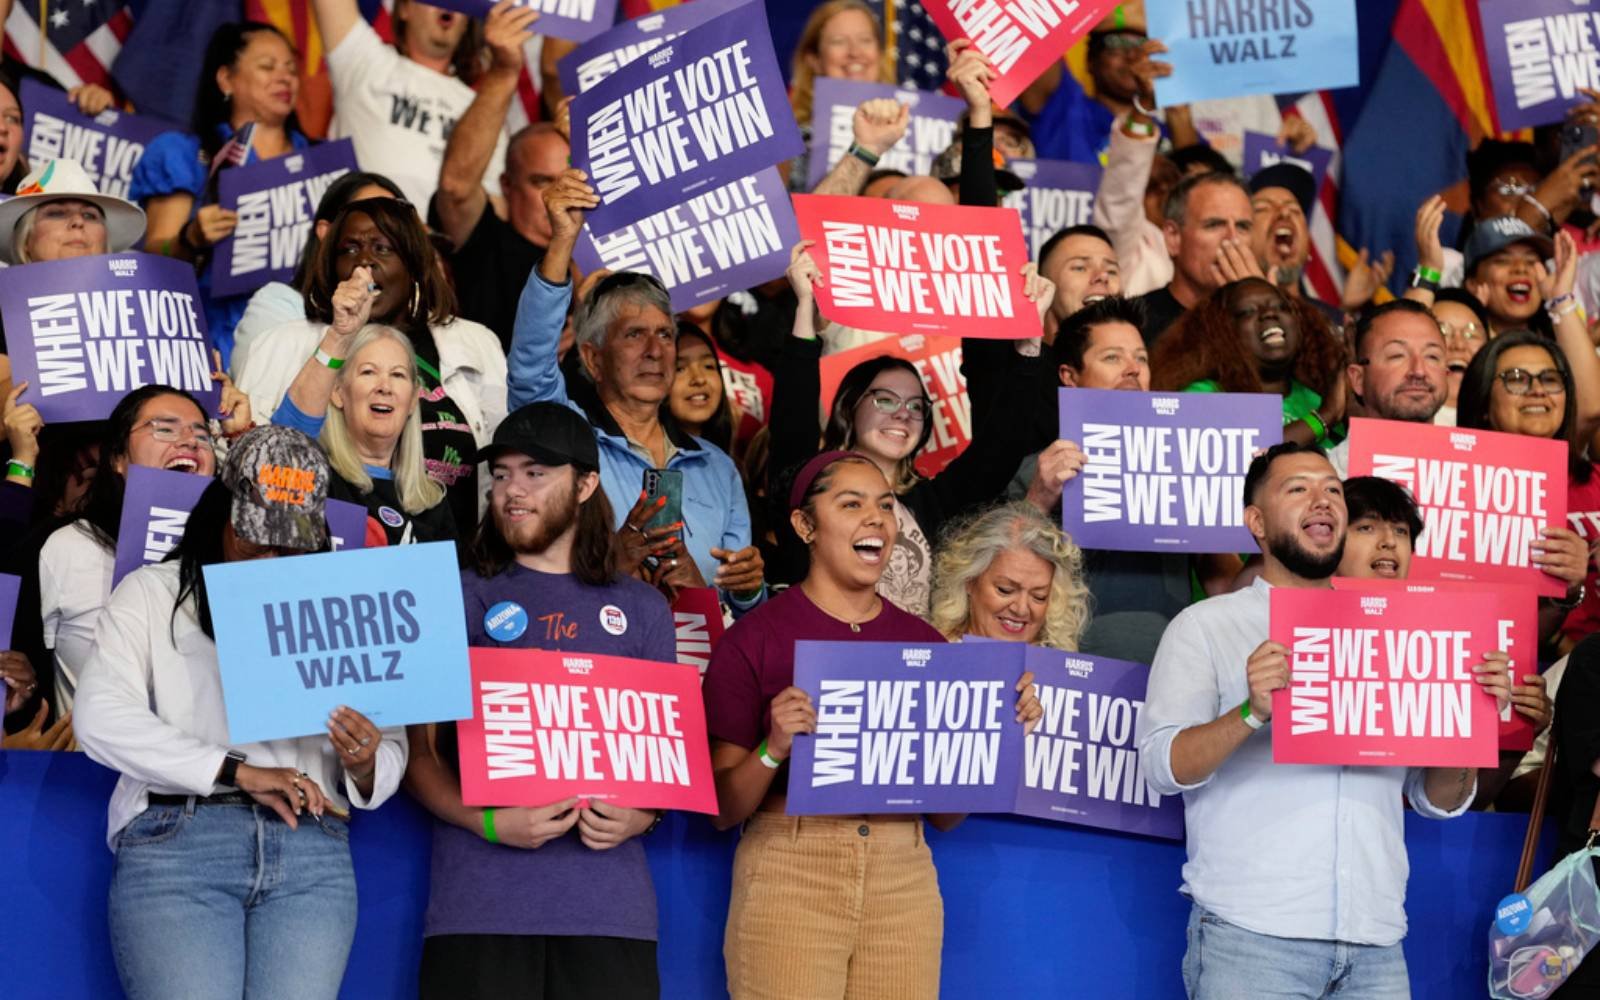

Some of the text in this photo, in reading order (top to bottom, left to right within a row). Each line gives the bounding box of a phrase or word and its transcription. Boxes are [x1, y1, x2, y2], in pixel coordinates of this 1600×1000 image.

[947, 0, 1032, 75] WHE
[1187, 0, 1313, 39] HARRIS
[1544, 11, 1596, 56] WE
[1209, 34, 1298, 65] WALZ
[1504, 17, 1556, 110] WHEN
[624, 75, 677, 134] WE
[674, 39, 757, 112] VOTE
[63, 122, 145, 182] WE VO
[587, 99, 641, 205] WHEN
[630, 118, 698, 186] WE
[687, 85, 774, 162] WIN
[270, 180, 310, 228] WE
[637, 204, 689, 241] WE
[230, 190, 270, 277] WHEN
[645, 202, 783, 290] WE WIN
[866, 225, 920, 271] WE
[920, 232, 1006, 273] VOTE
[822, 221, 874, 307] WHEN
[872, 267, 1015, 318] WE WIN
[78, 289, 203, 339] WE VOTE
[27, 293, 88, 396] WHEN
[85, 338, 213, 392] WE WIN
[1082, 423, 1122, 523] WHEN
[1123, 425, 1260, 474] WE VOTE
[1123, 473, 1178, 526] WE
[1418, 458, 1467, 508] WE
[1473, 464, 1547, 517] VOTE
[1415, 507, 1467, 561] WE
[263, 589, 420, 657] HARRIS
[538, 612, 579, 641] The
[296, 650, 404, 690] WALZ
[1291, 627, 1330, 735] WHEN
[1332, 628, 1379, 679] WE
[1384, 630, 1472, 680] VOTE
[480, 681, 536, 780] WHEN
[531, 683, 683, 738] WE VOTE
[812, 680, 865, 788] WHEN
[867, 680, 1005, 730] WE VOTE
[1033, 683, 1146, 749] WE VOT
[1331, 680, 1384, 737] WE
[1389, 682, 1472, 738] WIN
[536, 729, 691, 787] WE WIN
[861, 731, 1001, 785] WE WIN
[1025, 734, 1083, 795] WE
